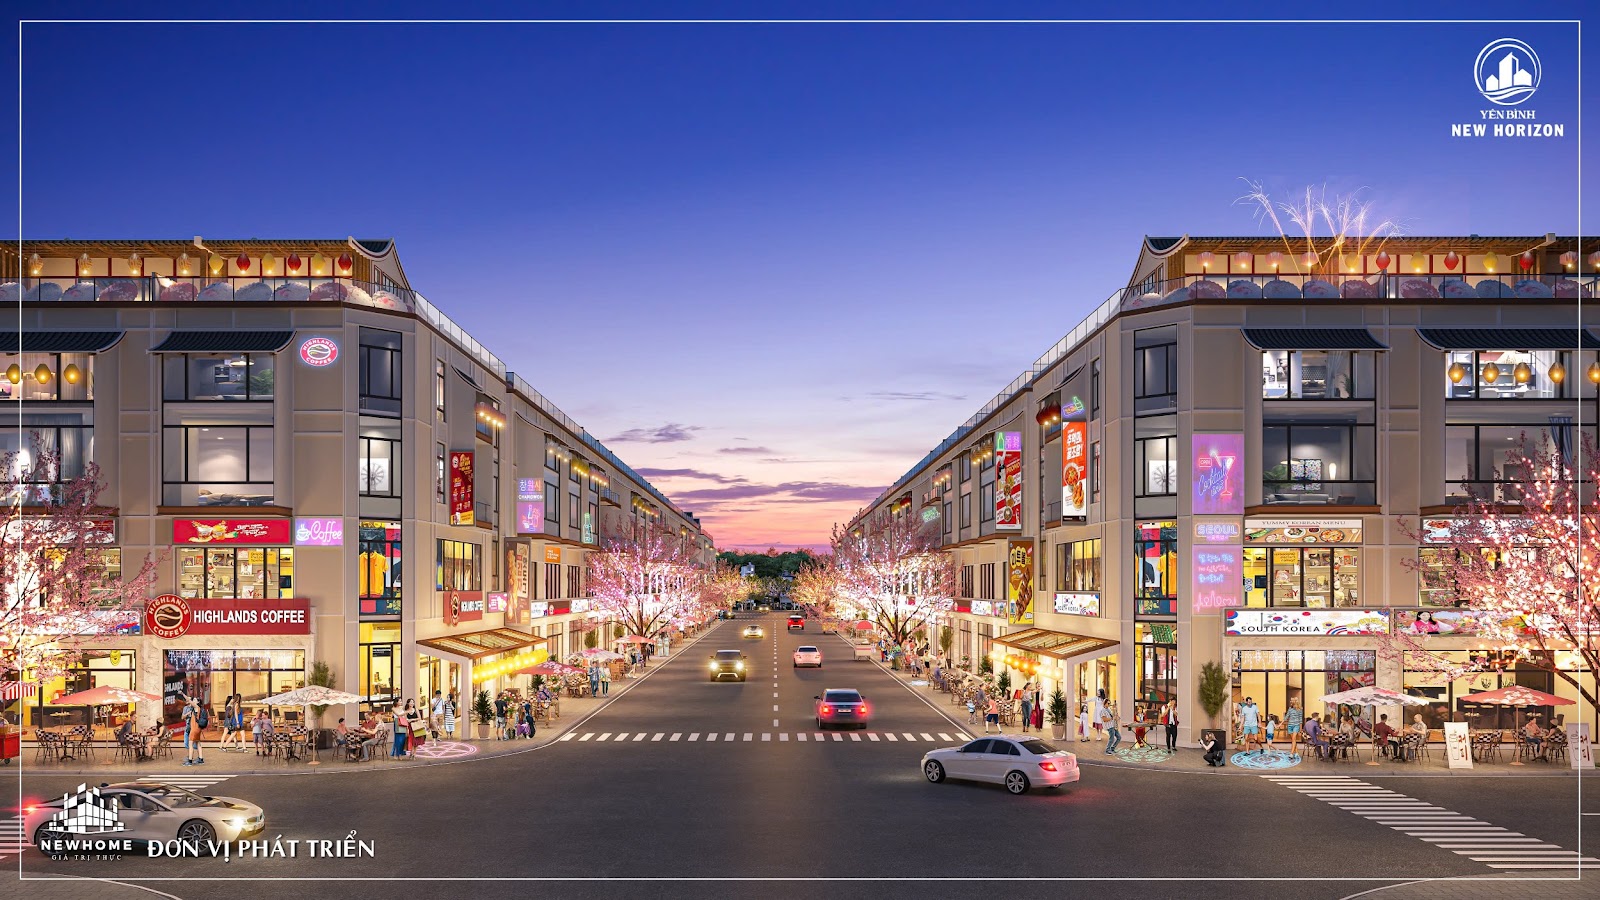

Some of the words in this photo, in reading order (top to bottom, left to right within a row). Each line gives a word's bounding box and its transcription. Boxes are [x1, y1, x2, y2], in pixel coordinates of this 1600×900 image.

[303, 339, 336, 351] HIGHLANDS
[306, 357, 332, 365] COFFEE
[309, 520, 342, 543] Coffee
[1197, 524, 1238, 535] SEOUL
[148, 595, 189, 615] HIGHLANDS
[193, 609, 258, 623] HIGHLANDS
[260, 609, 305, 623] COFFEE
[153, 625, 185, 637] COFFEE
